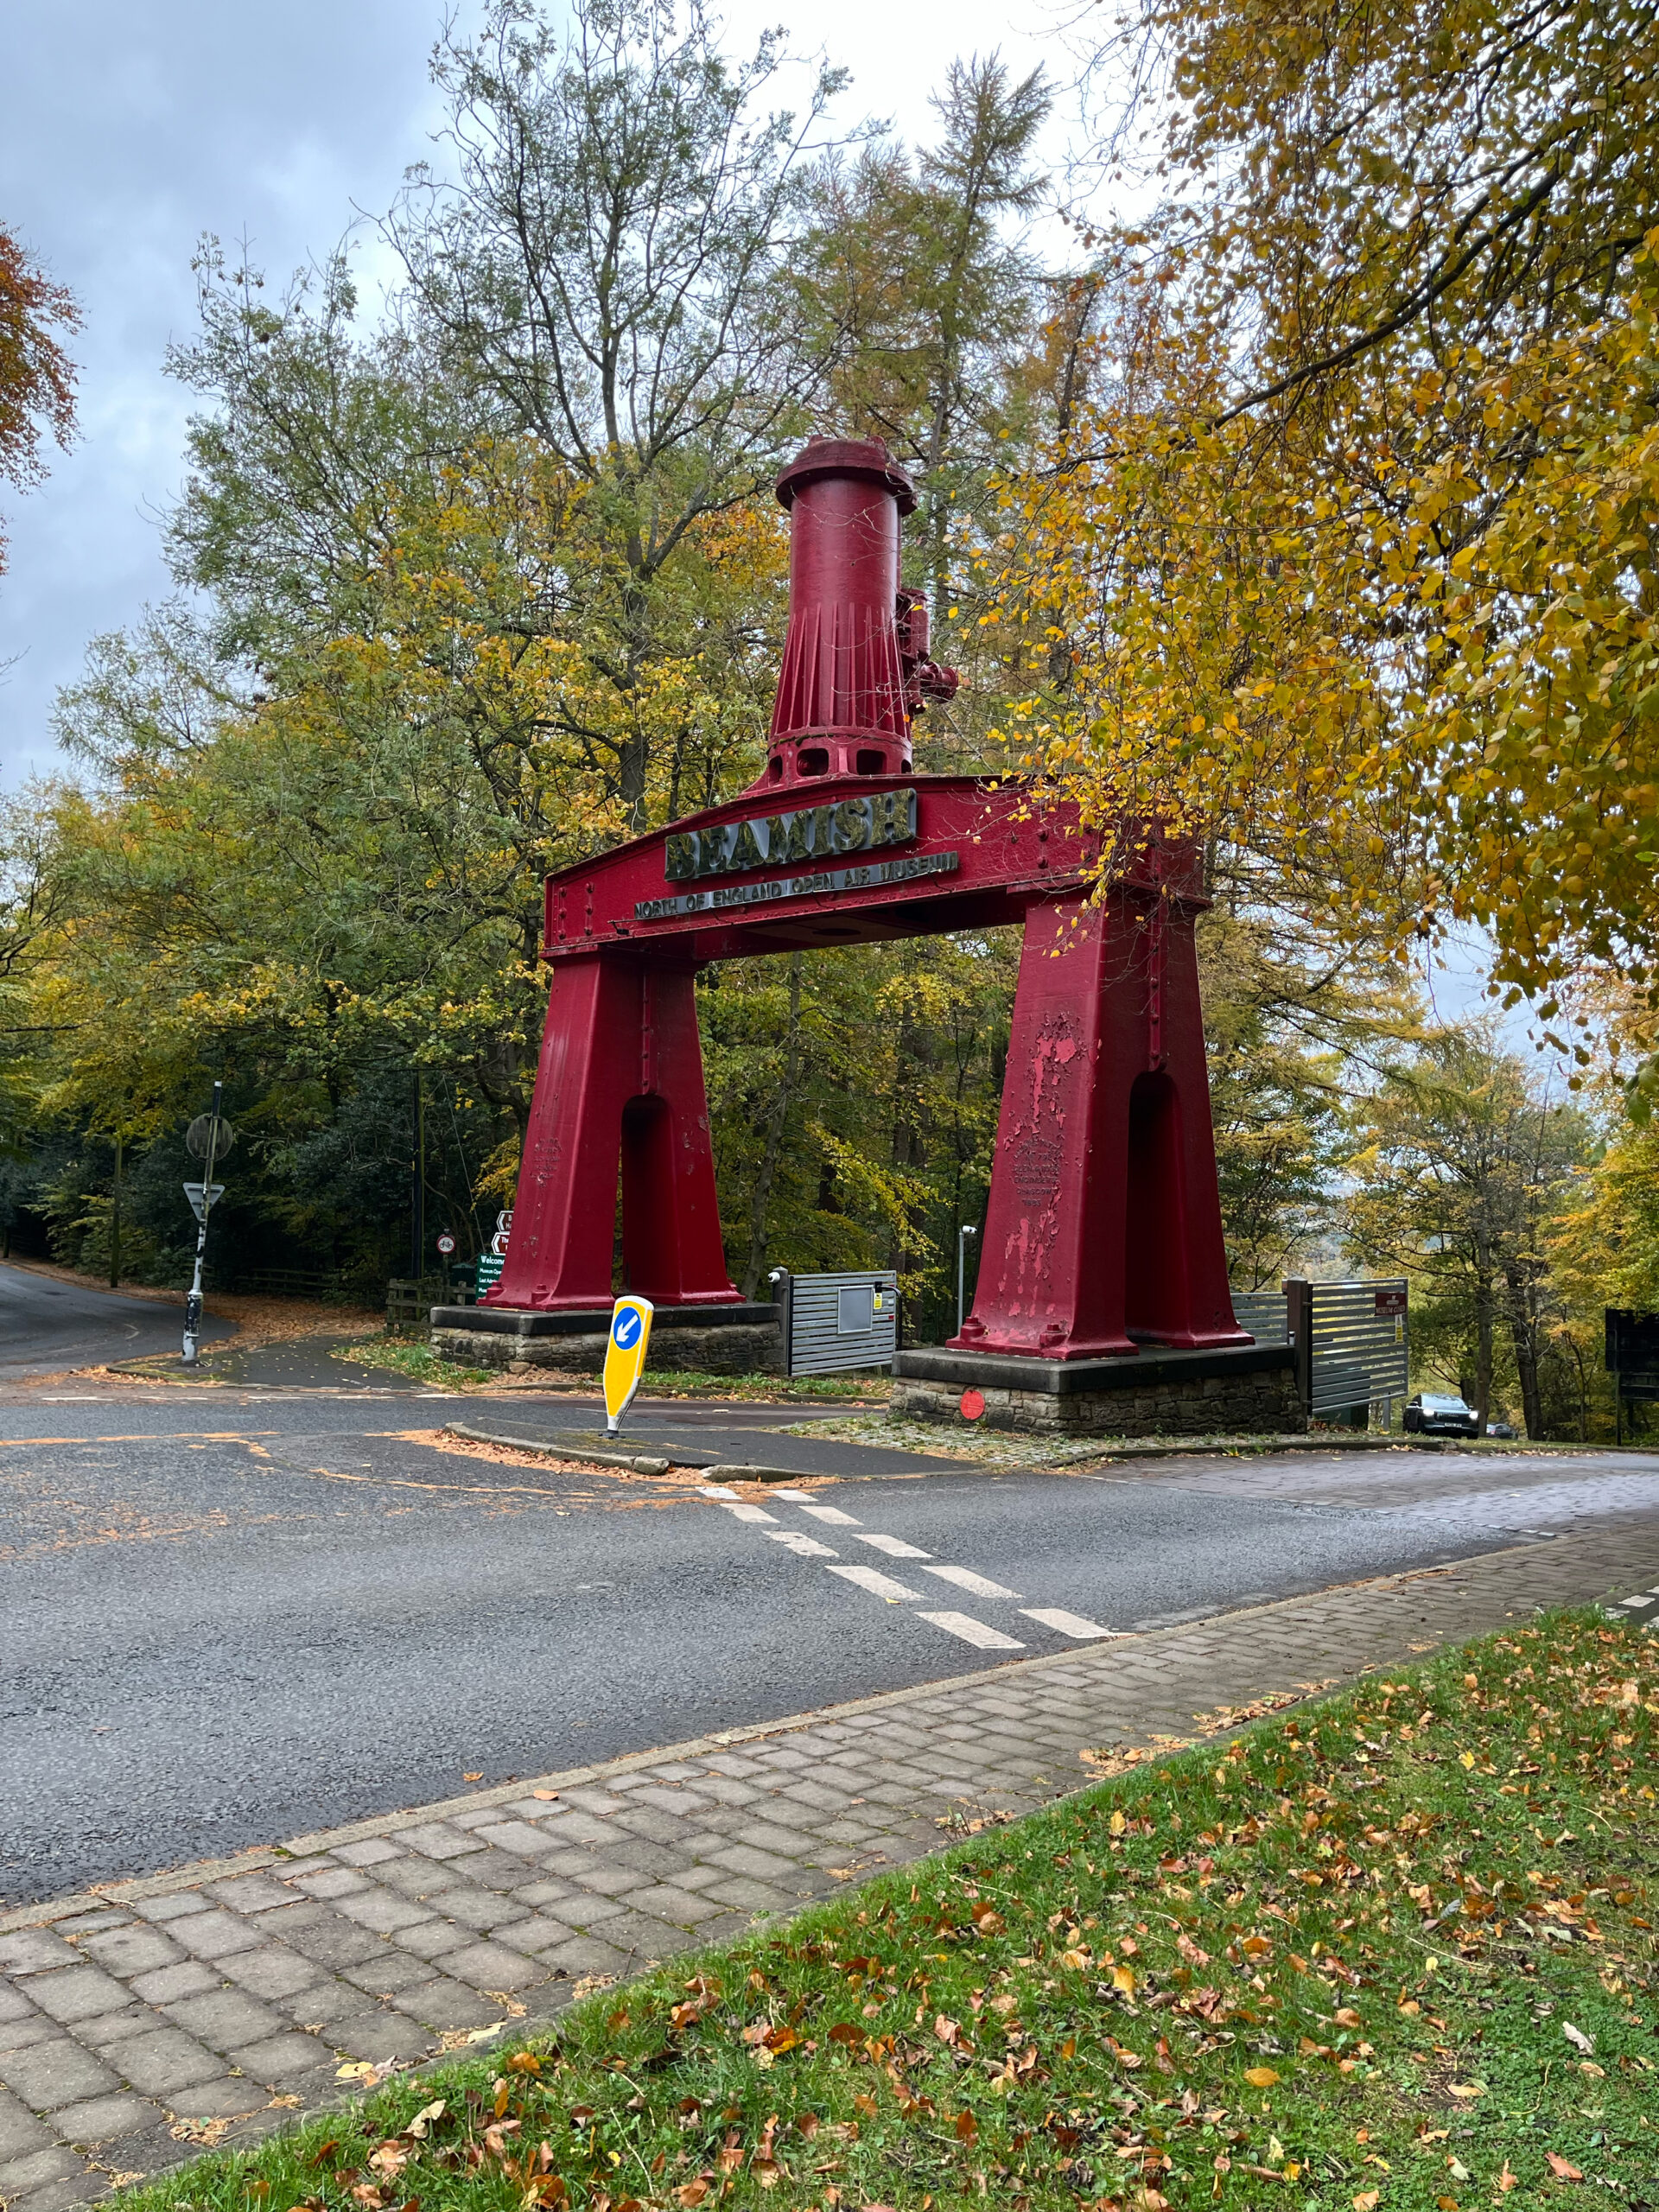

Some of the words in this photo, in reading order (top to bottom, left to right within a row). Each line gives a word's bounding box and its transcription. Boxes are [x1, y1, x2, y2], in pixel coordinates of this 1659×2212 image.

[664, 787, 915, 880] BEAMISH
[635, 899, 677, 919] NORTH
[686, 893, 705, 910] OF
[713, 880, 781, 906] ENGLAND
[792, 871, 835, 893] OPEN
[844, 865, 870, 887] AIR
[880, 851, 958, 881] MUSEUM
